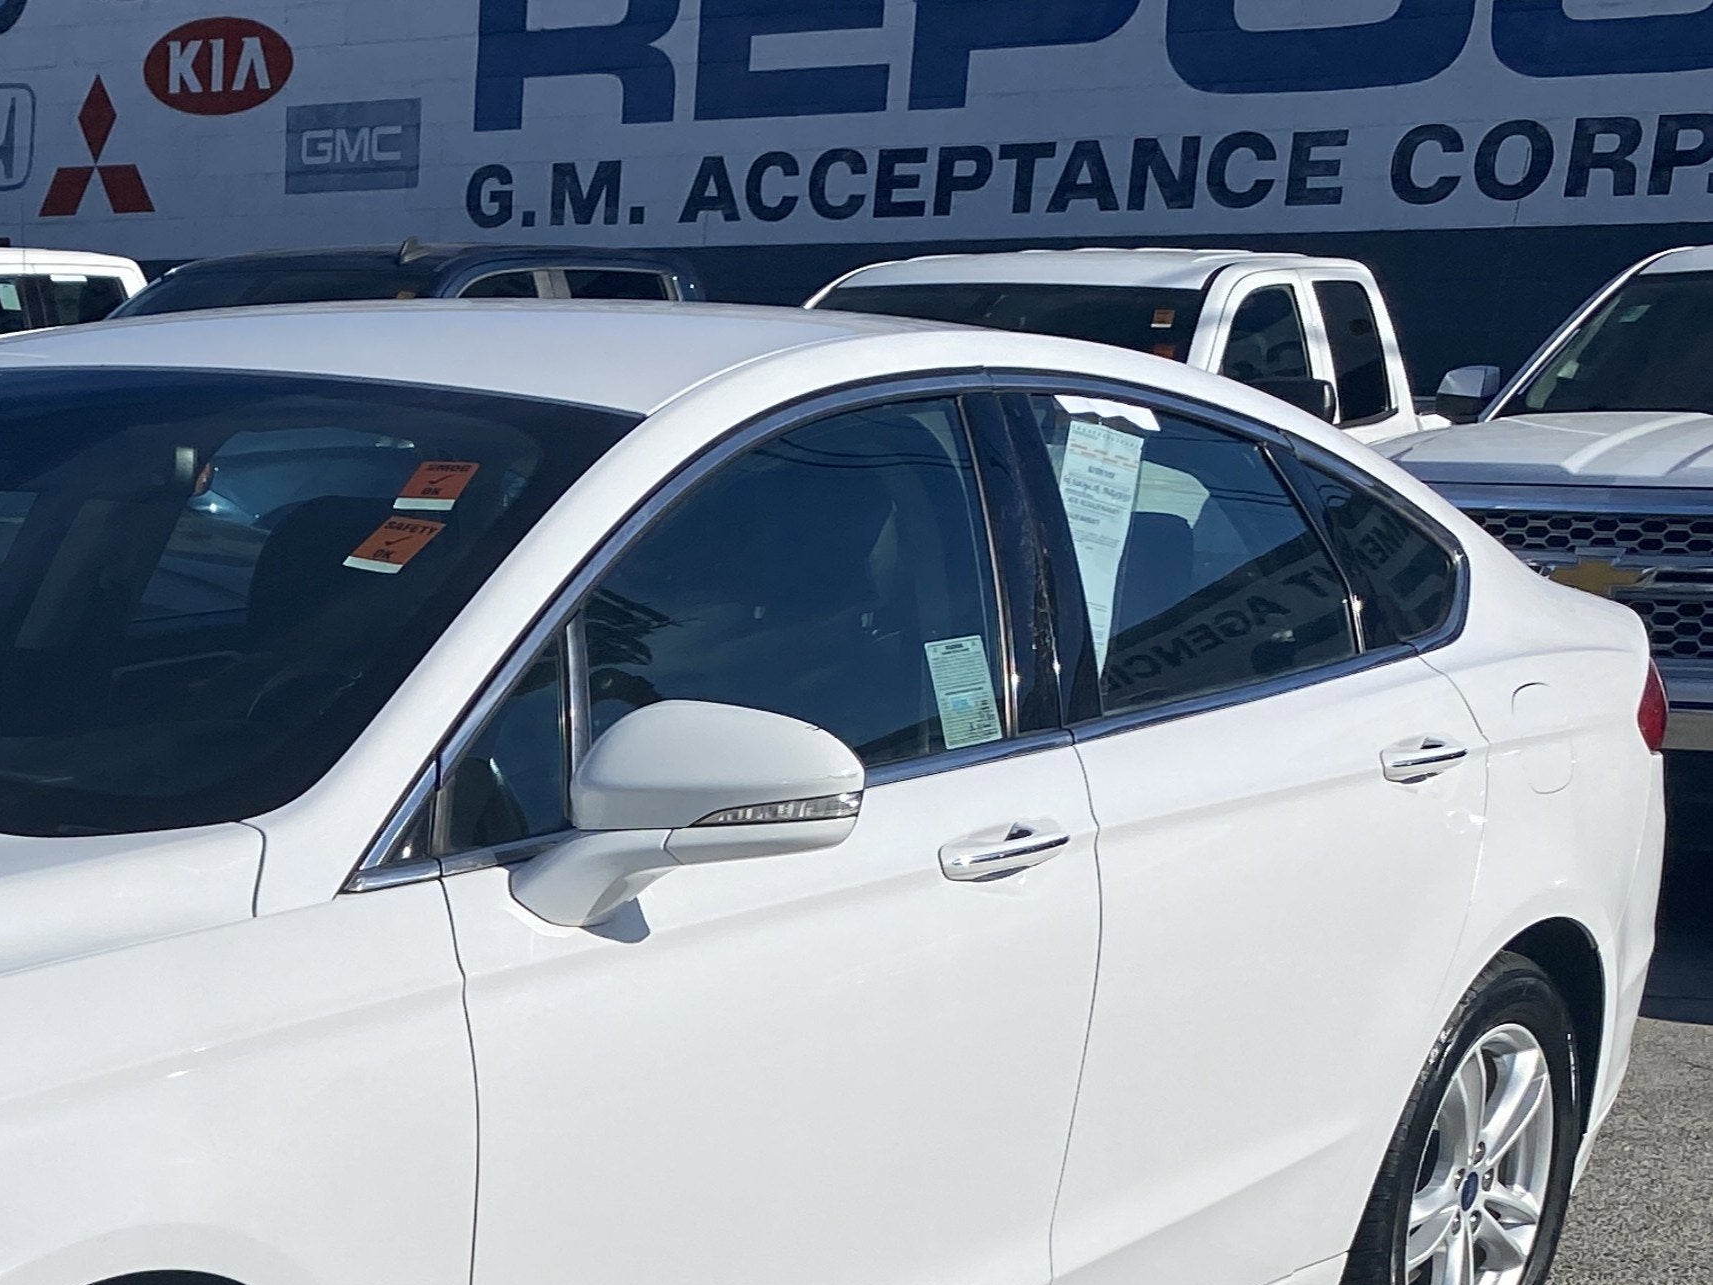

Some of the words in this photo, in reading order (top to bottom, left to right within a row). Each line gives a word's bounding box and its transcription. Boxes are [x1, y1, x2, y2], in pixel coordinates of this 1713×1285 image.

[168, 37, 271, 93] KIA
[301, 126, 402, 165] GMC
[465, 159, 646, 229] G.M.
[677, 130, 1349, 224] ACCEPTANCE
[422, 487, 442, 496] OK
[385, 521, 438, 535] SAFETY
[372, 549, 395, 560] OK
